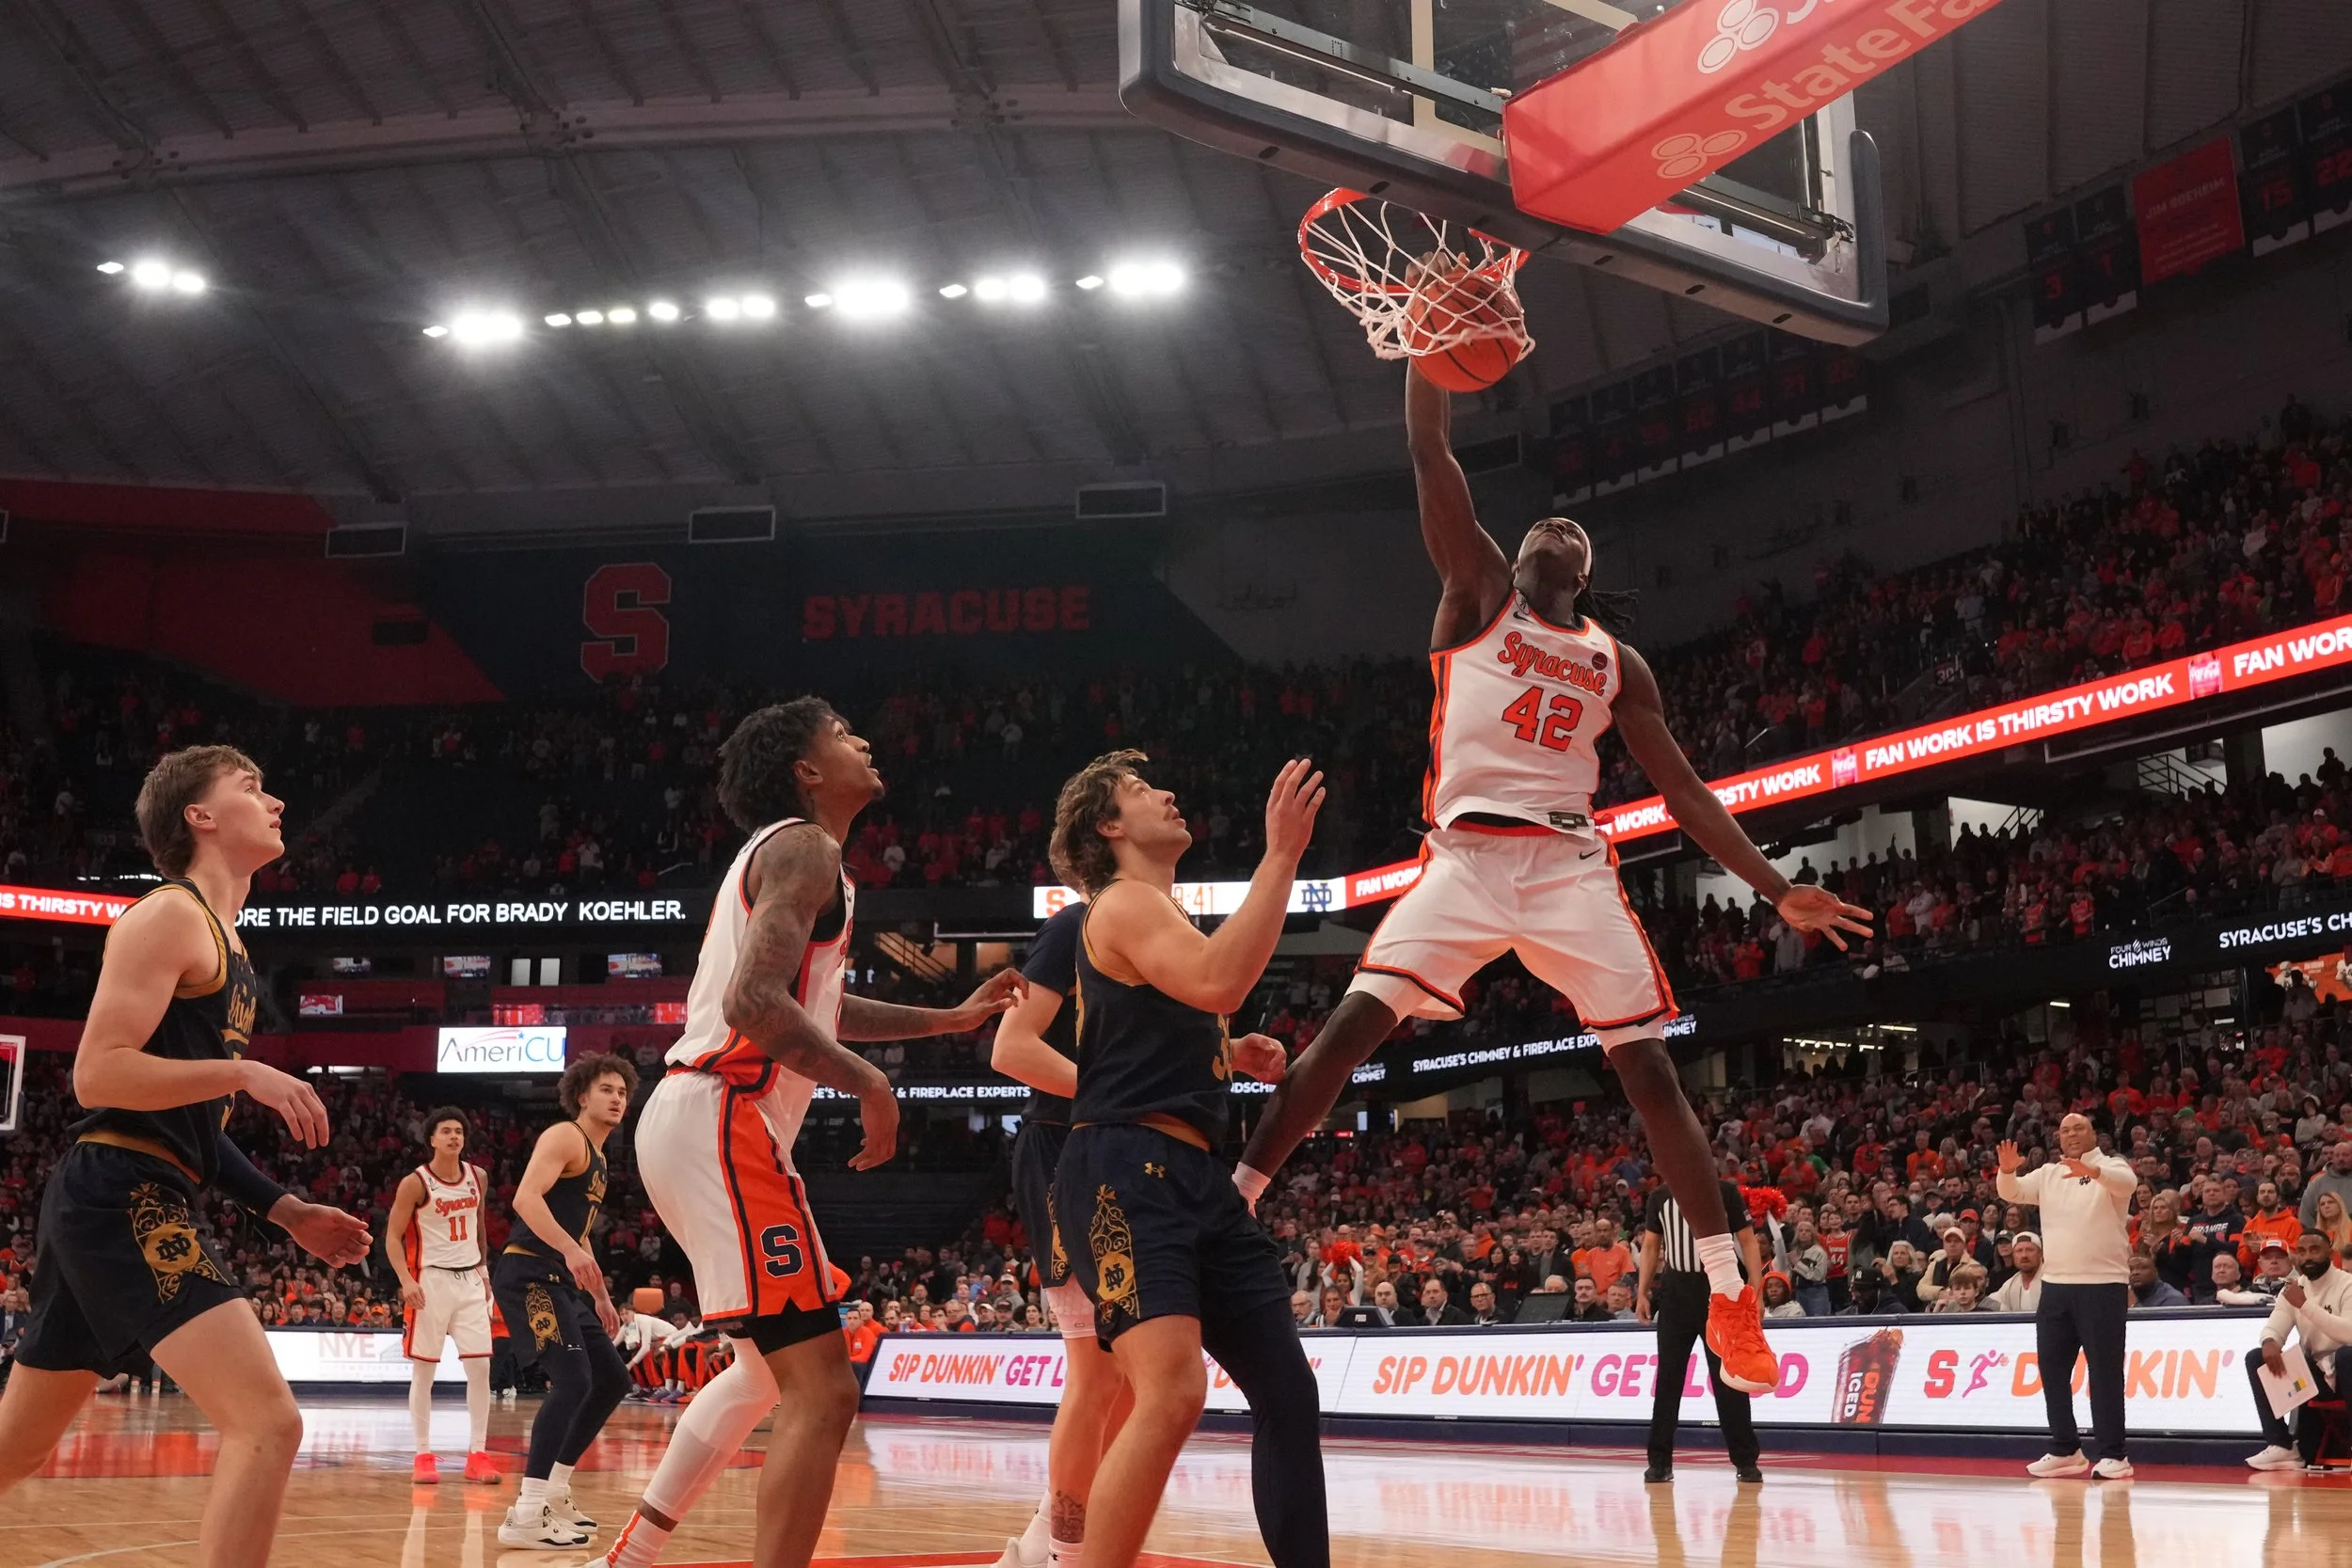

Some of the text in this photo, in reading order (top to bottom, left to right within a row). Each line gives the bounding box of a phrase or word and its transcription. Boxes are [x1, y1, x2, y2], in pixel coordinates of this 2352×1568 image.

[580, 562, 671, 683] S
[802, 587, 1090, 640] SYRACUSE
[1498, 631, 1607, 696] Syracuse
[2233, 643, 2284, 677] FAN
[1502, 686, 1583, 752] 42
[1865, 742, 1904, 770] FAN
[1906, 723, 1973, 760] WORK
[1975, 716, 1997, 743] IS
[1997, 691, 2094, 736] THIRSTY
[2095, 673, 2175, 712] WORK
[1761, 764, 1820, 796] WORK
[1614, 804, 1666, 833] WORK
[1046, 890, 1066, 916] S
[1356, 876, 1381, 897] FAN
[18, 895, 103, 917] THIRSTY
[278, 908, 316, 927] THE
[321, 906, 378, 926] FIELD
[384, 905, 441, 925] GOAL
[447, 904, 490, 924] FOR
[496, 902, 568, 922] BRADY
[579, 900, 686, 921] KOEHLER.
[2218, 916, 2322, 949] SYRACUSE'S
[2108, 945, 2170, 969] CHIMNEY
[440, 1036, 566, 1063] AmeriCU
[1413, 1052, 1467, 1073] SYRACUSE'S
[1468, 1046, 1511, 1067] CHIMNEY
[1513, 1045, 1521, 1058] &
[1522, 1037, 1576, 1057] FIREPLACE
[897, 1087, 906, 1099] &
[910, 1086, 974, 1099] FIREPLACE
[977, 1086, 1031, 1098] EXPERTS
[448, 1215, 468, 1242] 11
[760, 1224, 803, 1277] S
[319, 1334, 376, 1358] NYE
[889, 1354, 921, 1383] SIP
[921, 1354, 1005, 1386] DUNKIN'
[1006, 1354, 1052, 1386] GET
[1373, 1355, 1428, 1396] SIP
[1431, 1354, 1583, 1397] DUNKIN'
[1923, 1349, 1959, 1399] S
[2010, 1349, 2233, 1400] DKIN'
[1844, 1372, 1863, 1418] ICED
